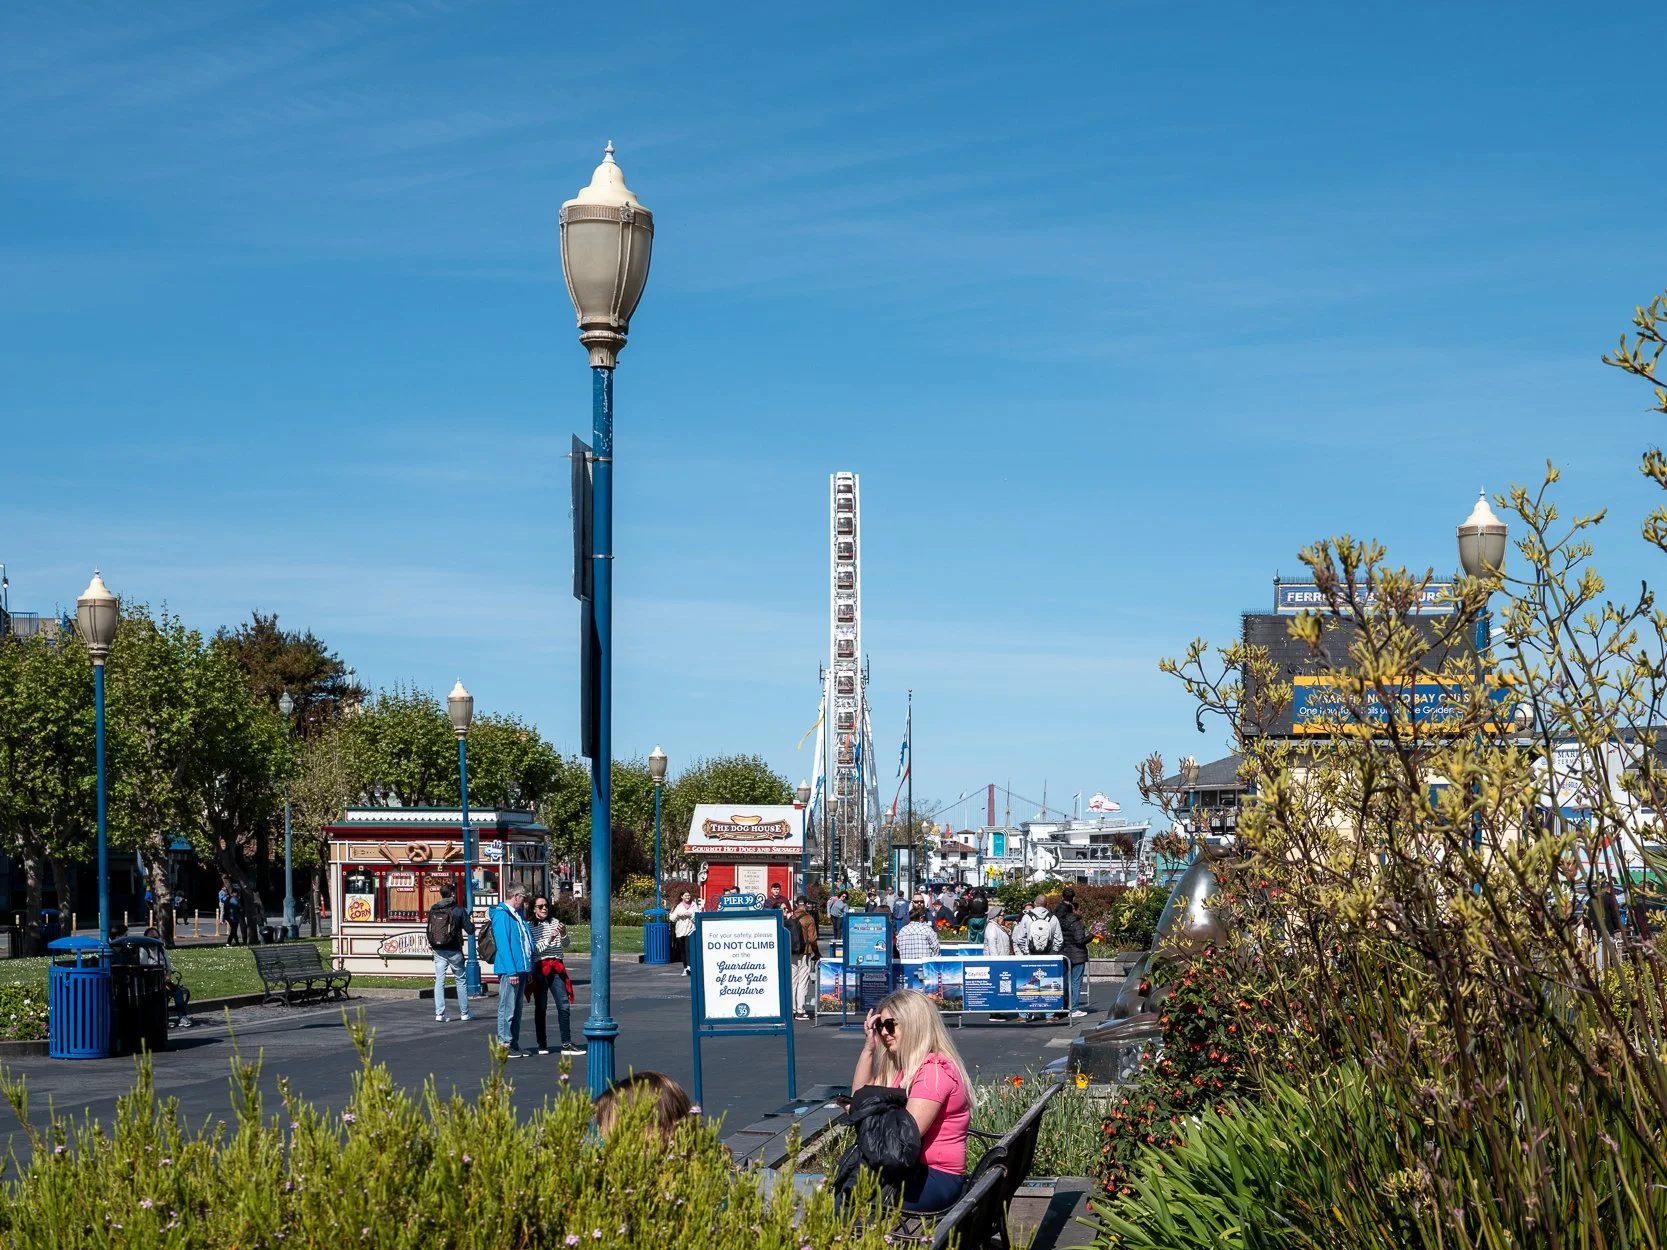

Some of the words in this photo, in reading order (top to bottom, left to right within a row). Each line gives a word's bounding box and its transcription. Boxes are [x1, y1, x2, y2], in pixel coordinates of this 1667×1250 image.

[1287, 591, 1345, 602] FERRIS
[1415, 693, 1436, 703] BAY
[1300, 707, 1318, 715] One
[710, 824, 729, 832] THE
[730, 824, 749, 832] DOG
[751, 824, 782, 832] HOUSE
[723, 896, 743, 905] PIER
[744, 896, 754, 904] 39
[753, 932, 773, 940] please
[707, 941, 721, 950] DO
[723, 941, 743, 950] NOT
[745, 941, 775, 949] CLIMB
[716, 960, 767, 973] Guardians
[715, 973, 727, 985] of
[727, 973, 743, 983] the
[744, 973, 768, 985] Gate
[719, 985, 765, 997] Sculpture
[738, 1008, 748, 1016] 39
